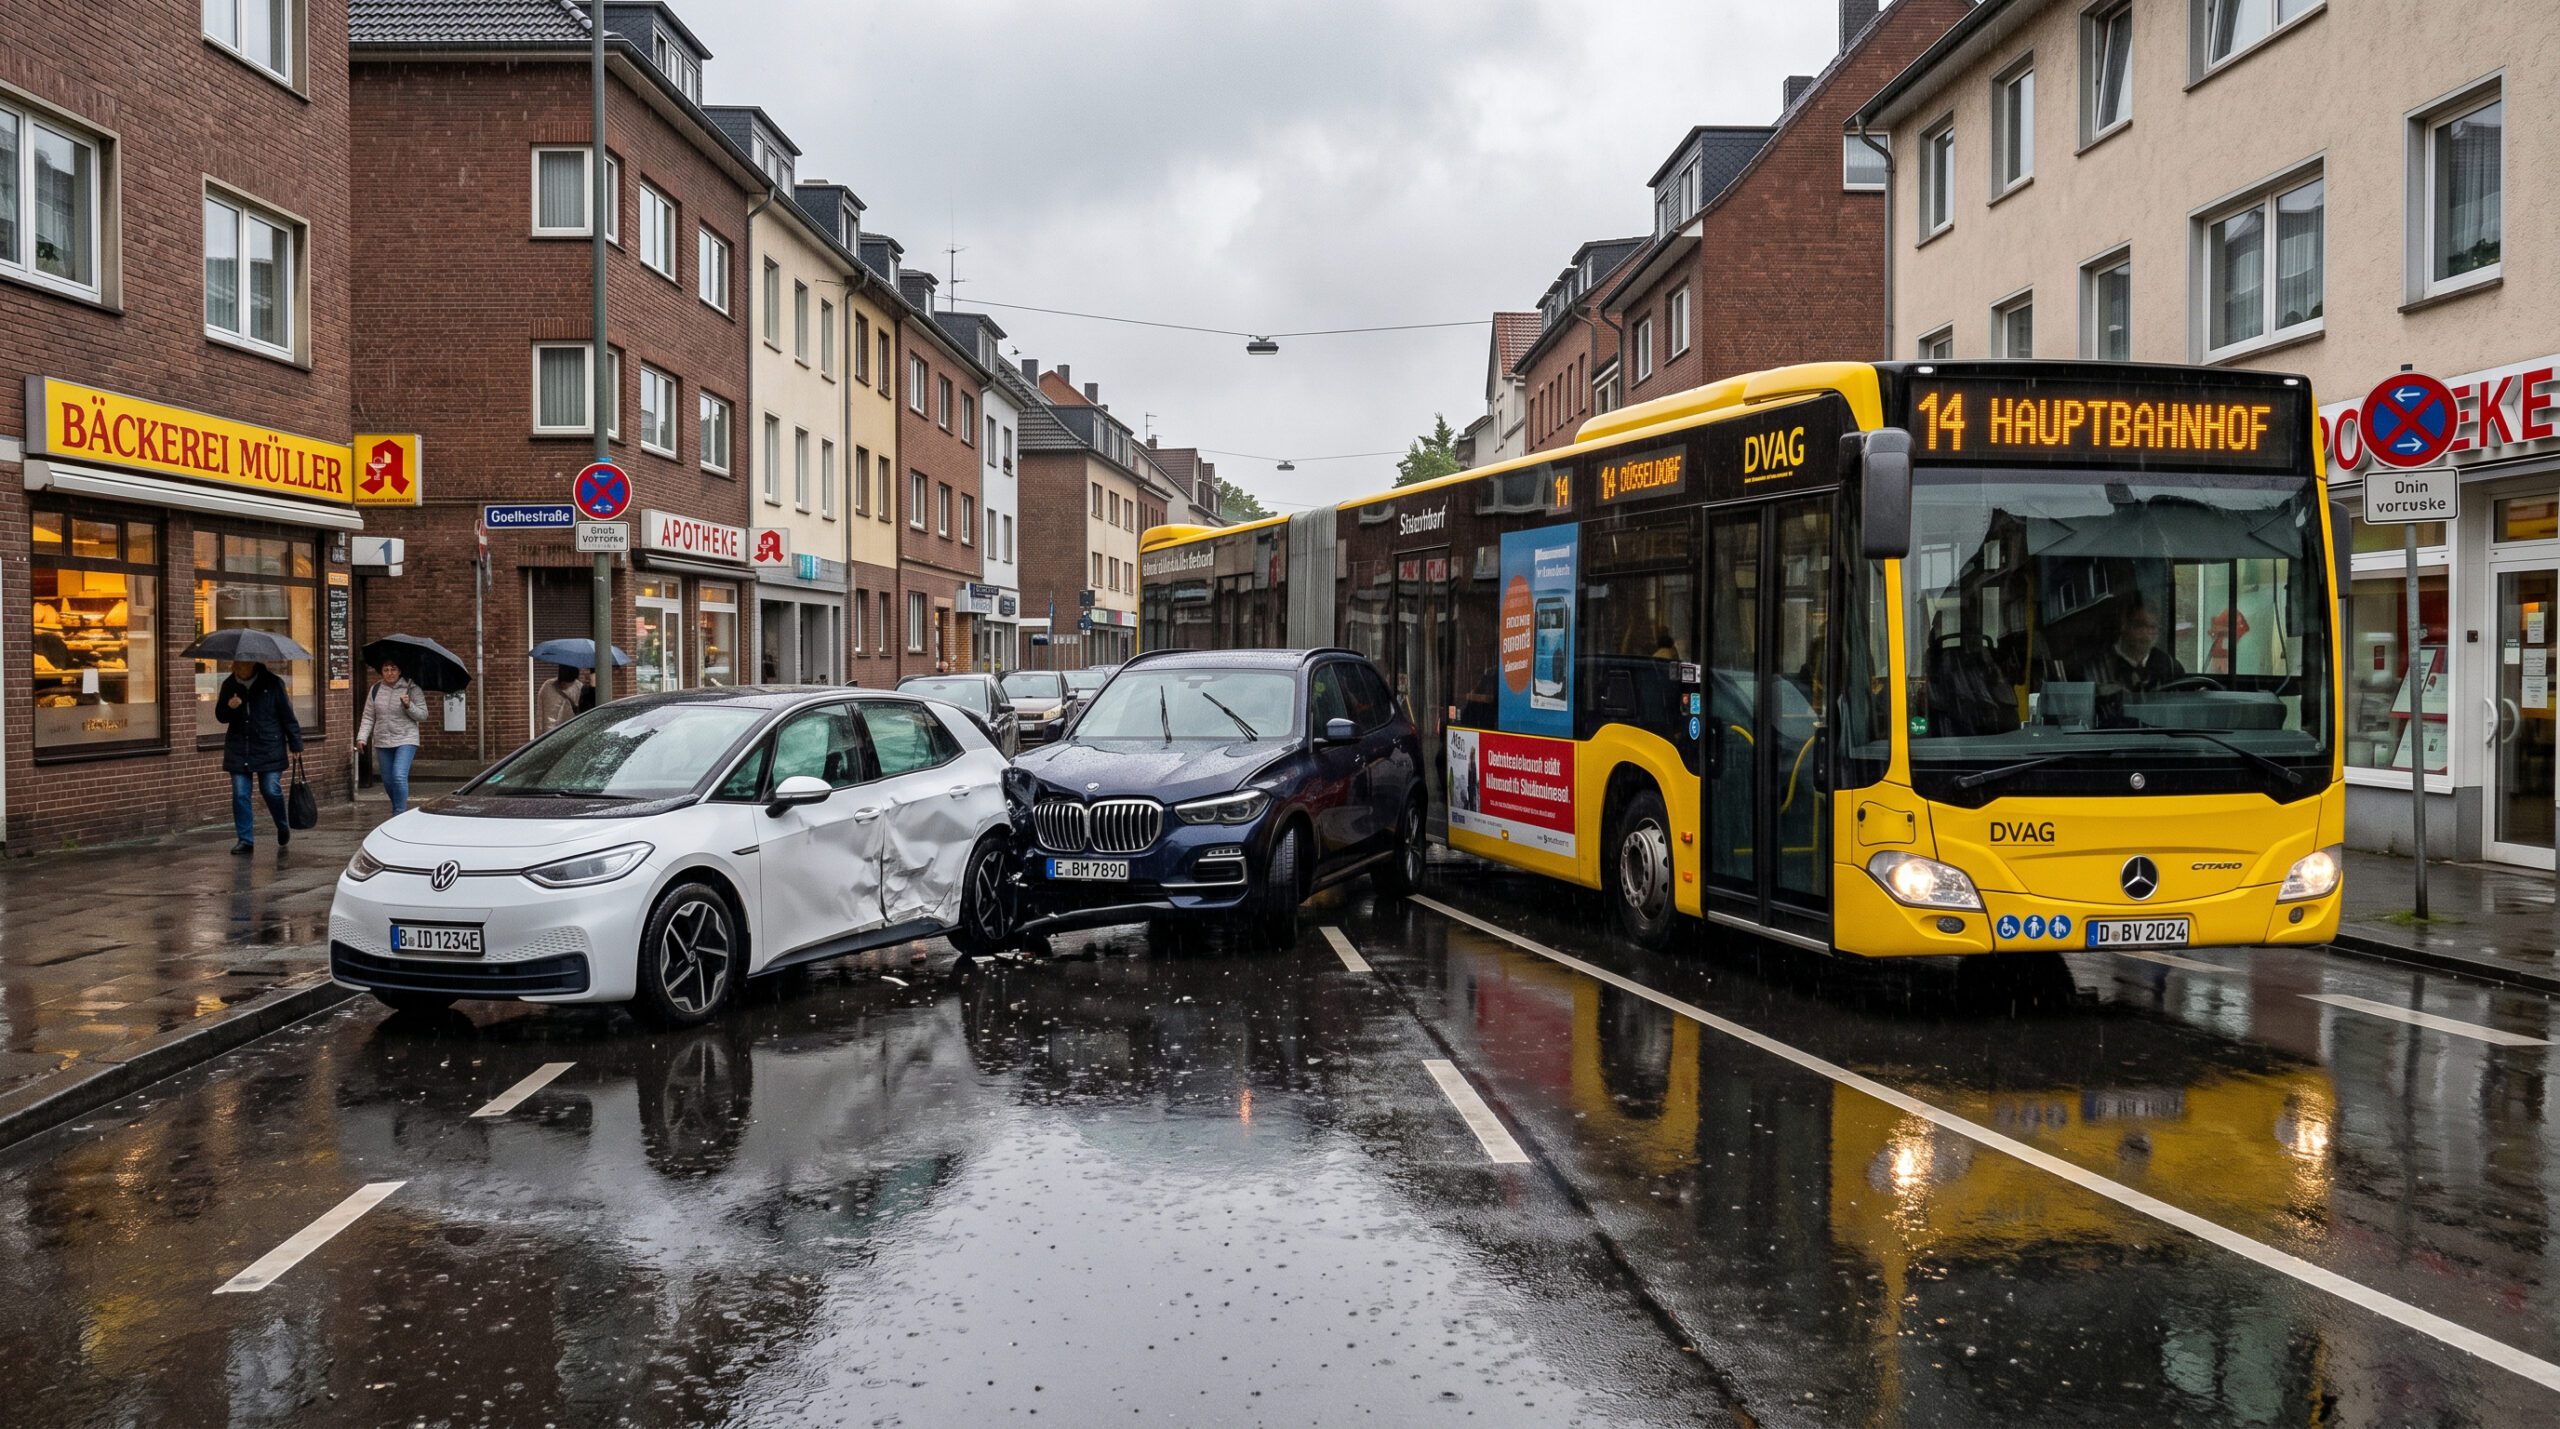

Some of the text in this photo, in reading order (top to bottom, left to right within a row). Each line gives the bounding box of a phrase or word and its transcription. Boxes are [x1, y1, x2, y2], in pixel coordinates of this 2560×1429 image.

[1917, 392, 2272, 450] 14 HAUPTBAHNHOF
[61, 395, 343, 494] BÄCKEREI MÜLLER
[1744, 426, 1805, 474] DVAG
[1555, 475, 1569, 508] 14
[1601, 466, 1616, 500] 14
[661, 517, 738, 558] APOTHEKE
[1990, 821, 2055, 842] DVAG
[1055, 861, 1064, 876] E
[2191, 862, 2243, 870] CITARO
[399, 929, 408, 947] B
[2099, 924, 2110, 942] D
[2145, 922, 2186, 941] 2024
